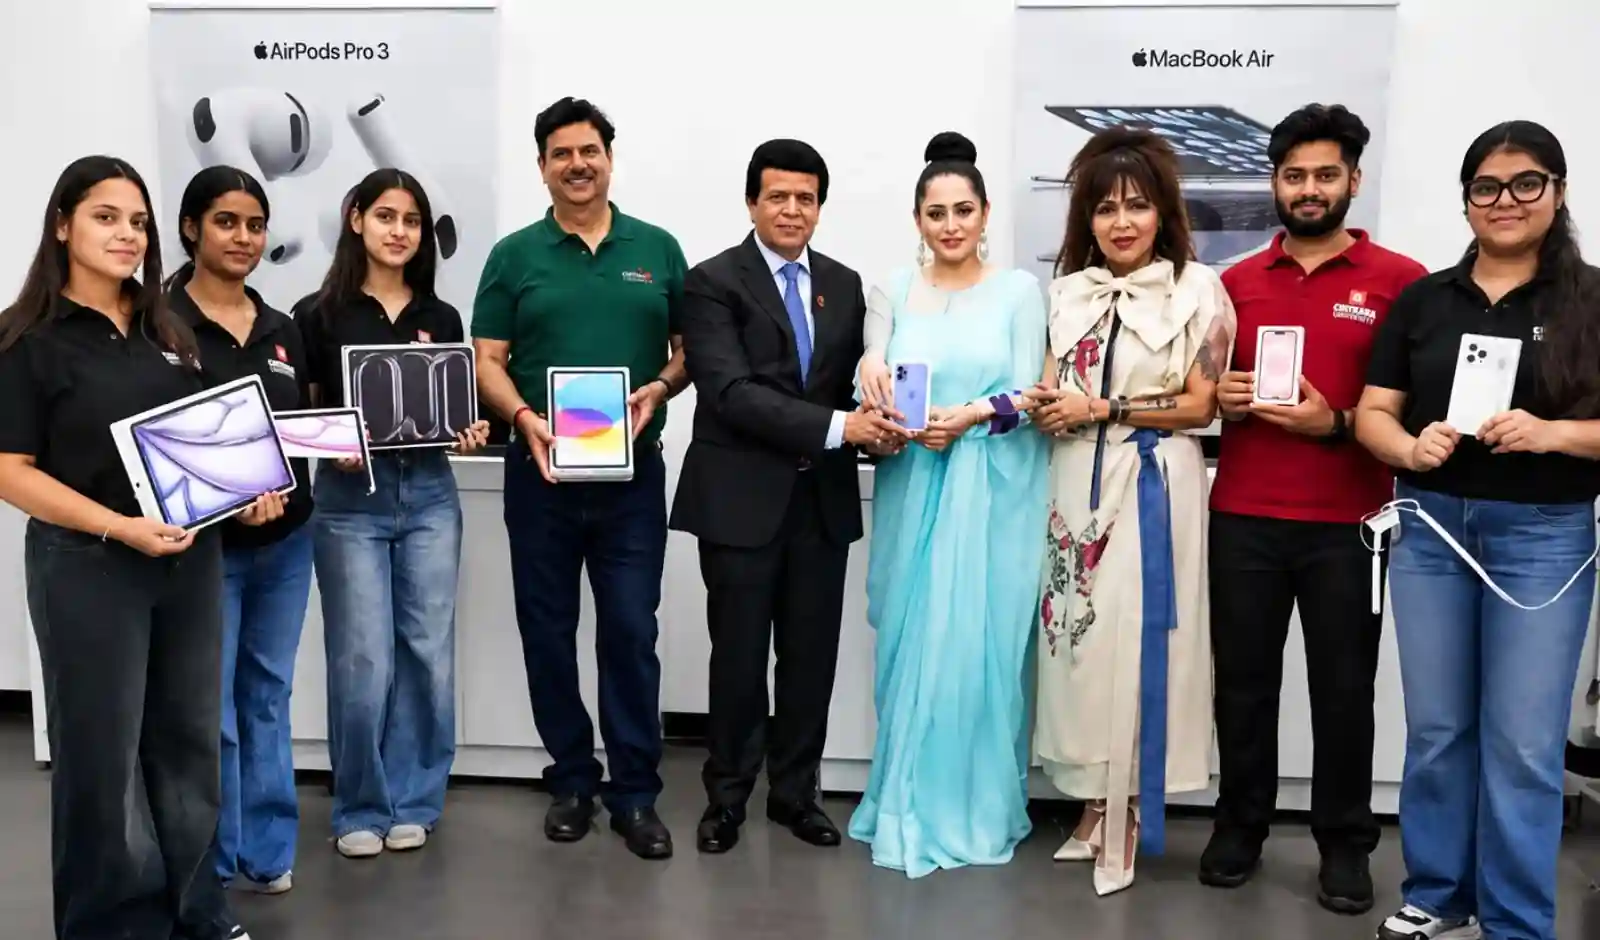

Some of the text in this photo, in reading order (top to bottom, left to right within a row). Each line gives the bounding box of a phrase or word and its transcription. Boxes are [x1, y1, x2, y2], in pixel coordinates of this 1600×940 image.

[270, 42, 389, 60] AirPods Pro 3
[1150, 49, 1274, 67] MacBook Air
